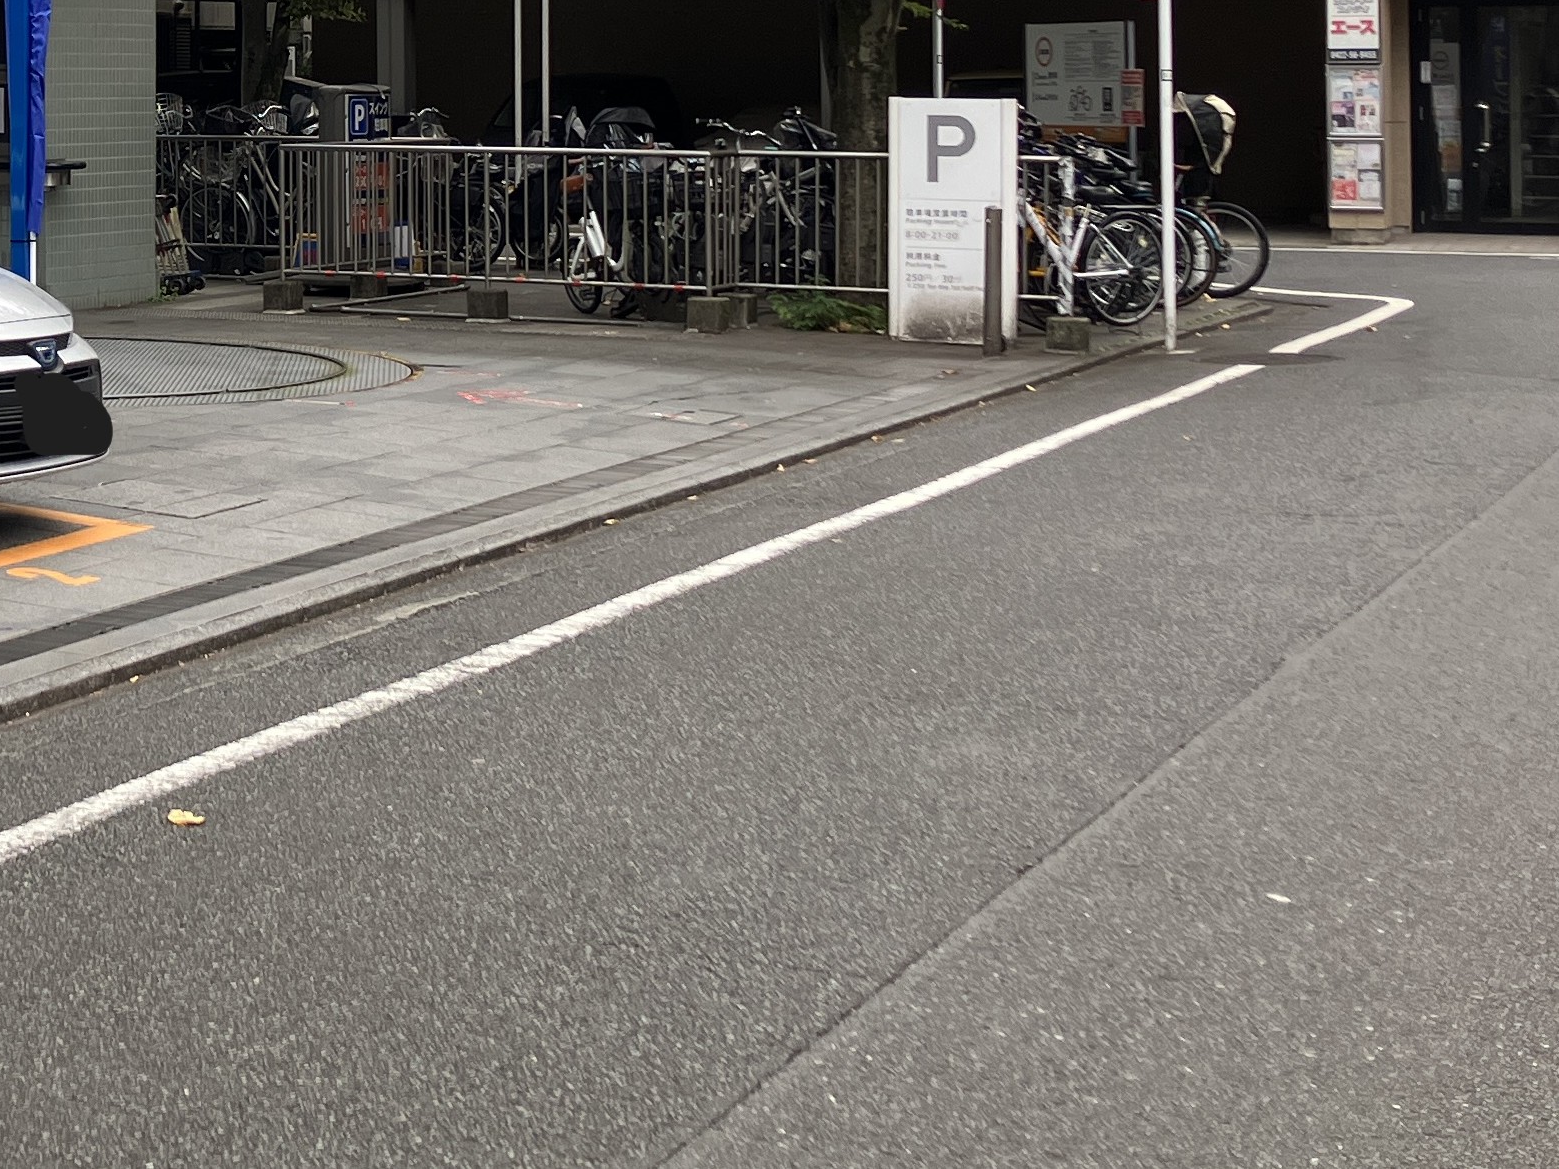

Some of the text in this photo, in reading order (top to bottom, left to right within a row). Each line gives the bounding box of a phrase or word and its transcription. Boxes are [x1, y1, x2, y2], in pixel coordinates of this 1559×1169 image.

[1331, 20, 1376, 35] エース
[354, 104, 365, 131] P
[927, 115, 976, 182] P
